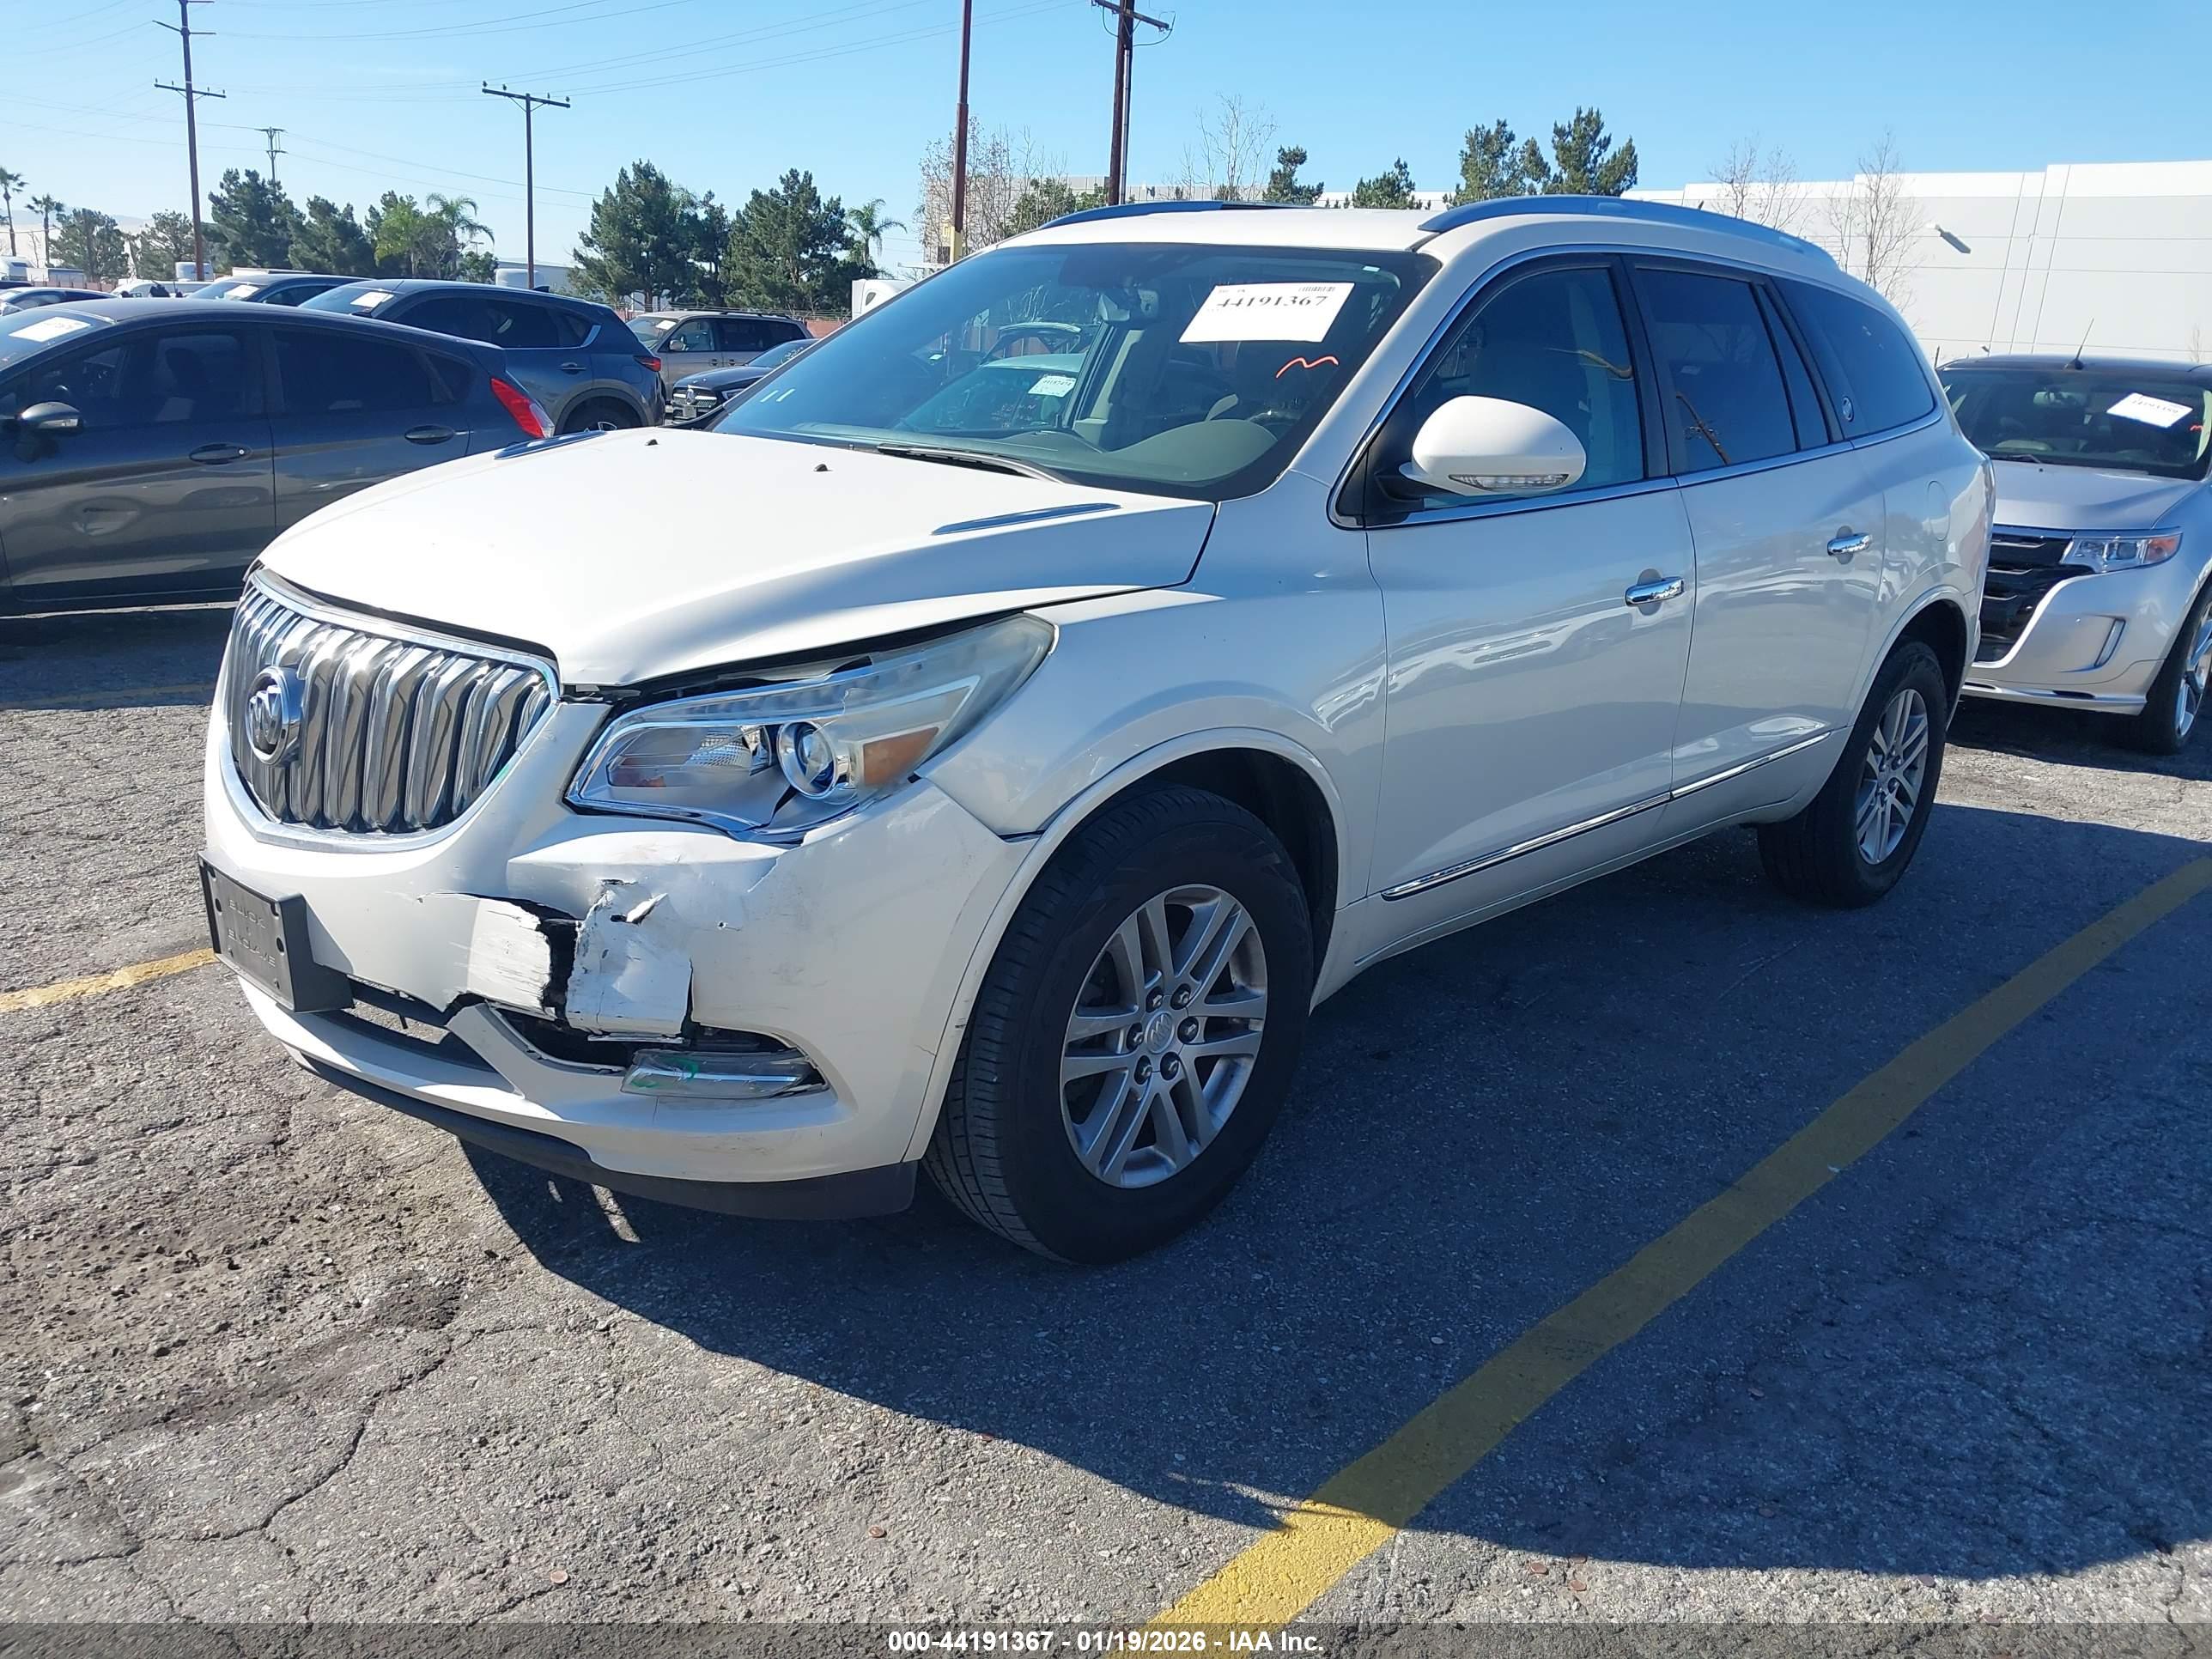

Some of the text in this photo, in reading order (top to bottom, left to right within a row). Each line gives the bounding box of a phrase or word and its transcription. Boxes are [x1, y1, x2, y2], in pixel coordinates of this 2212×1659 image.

[1216, 295, 1328, 308] 44191367
[228, 899, 267, 929] BUICK
[228, 928, 276, 968] ENCLAVE
